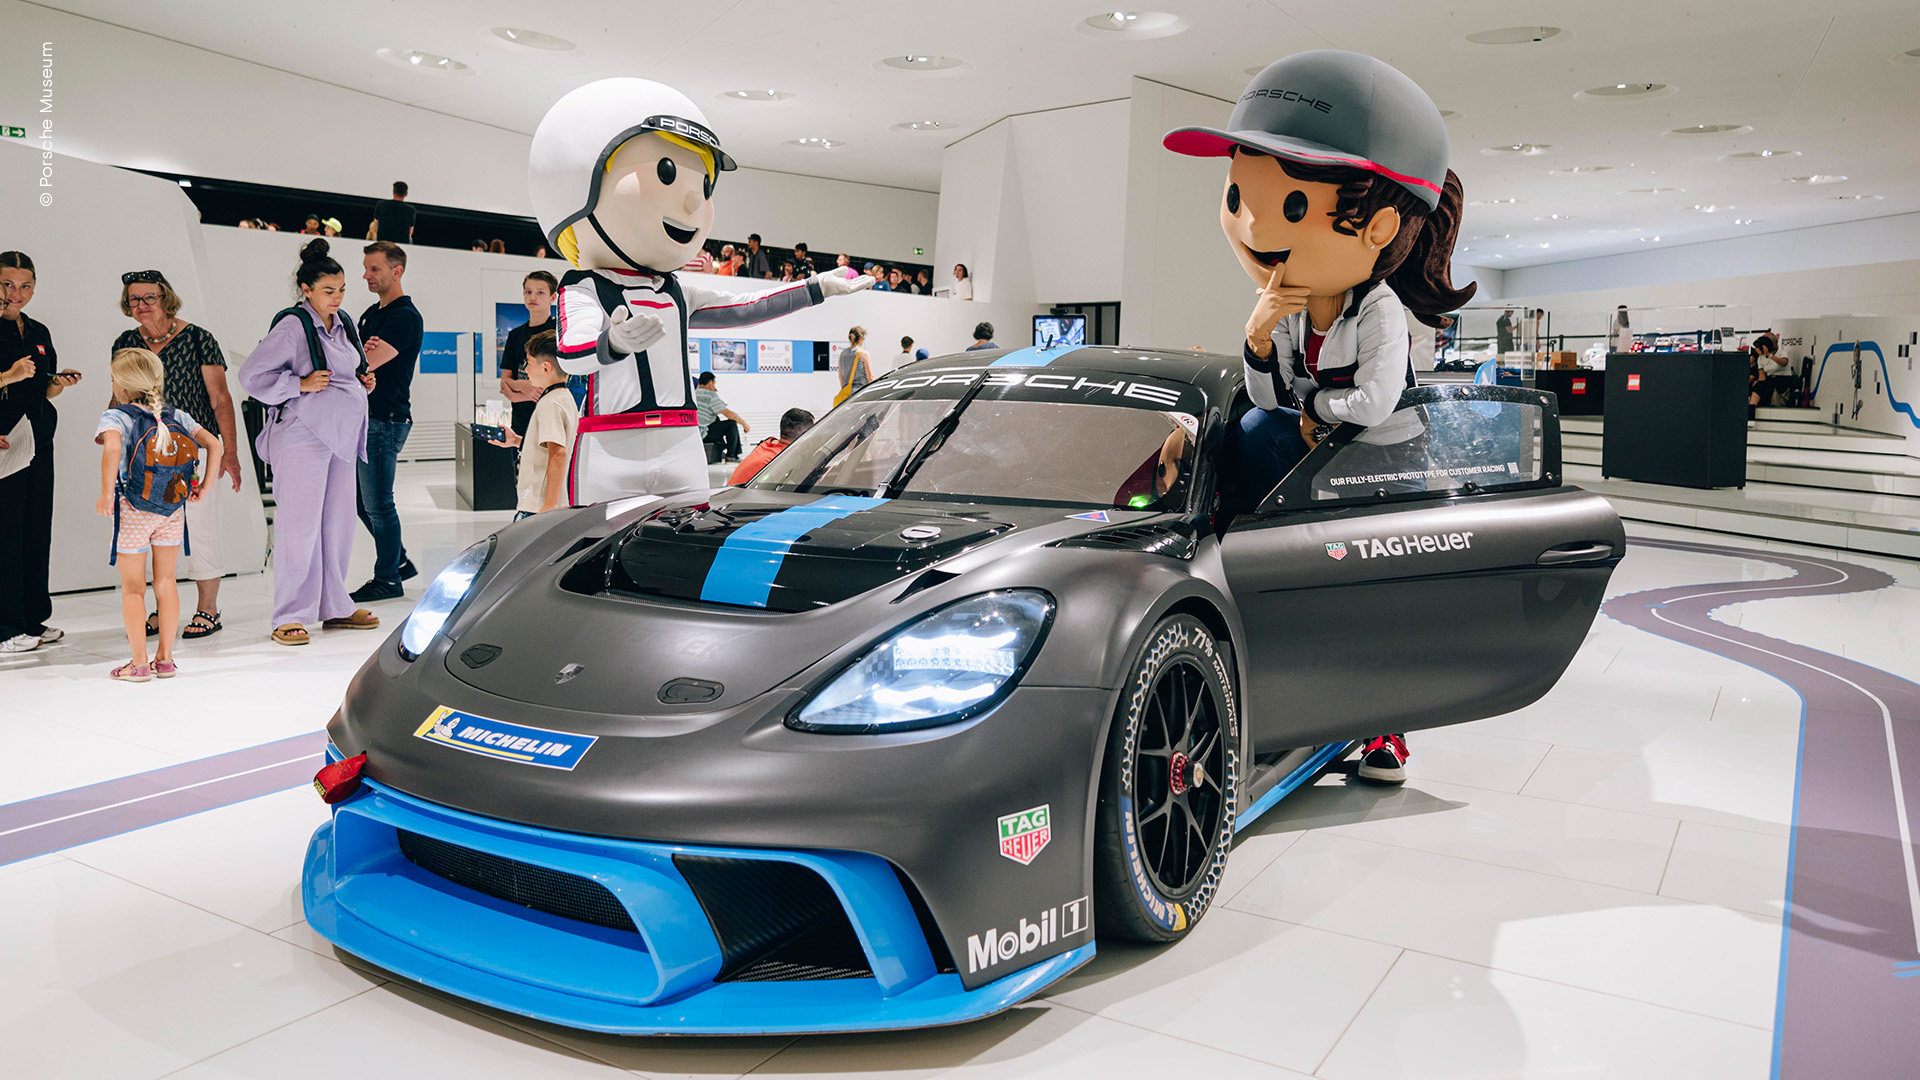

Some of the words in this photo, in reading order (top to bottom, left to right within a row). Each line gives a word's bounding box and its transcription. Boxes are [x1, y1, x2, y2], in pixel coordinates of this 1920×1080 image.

[857, 373, 1182, 406] PORSCHE
[679, 412, 694, 423] TOM
[1330, 477, 1346, 486] OUR
[1345, 473, 1399, 485] FULLY-ELECTRIC
[1399, 469, 1436, 481] PROTOTYPE
[1435, 468, 1449, 477] FOR
[1448, 465, 1482, 476] CUSTOMER
[1482, 464, 1506, 473] RACING
[1192, 626, 1214, 657] 71%
[1212, 659, 1236, 737] MATERIALS
[457, 726, 572, 757] MICHELIN
[1002, 809, 1046, 835] TAG
[1003, 829, 1048, 860] HEUER
[1124, 810, 1166, 921] MICHELIN
[967, 907, 1057, 974] Mobil
[1069, 901, 1080, 931] 1
